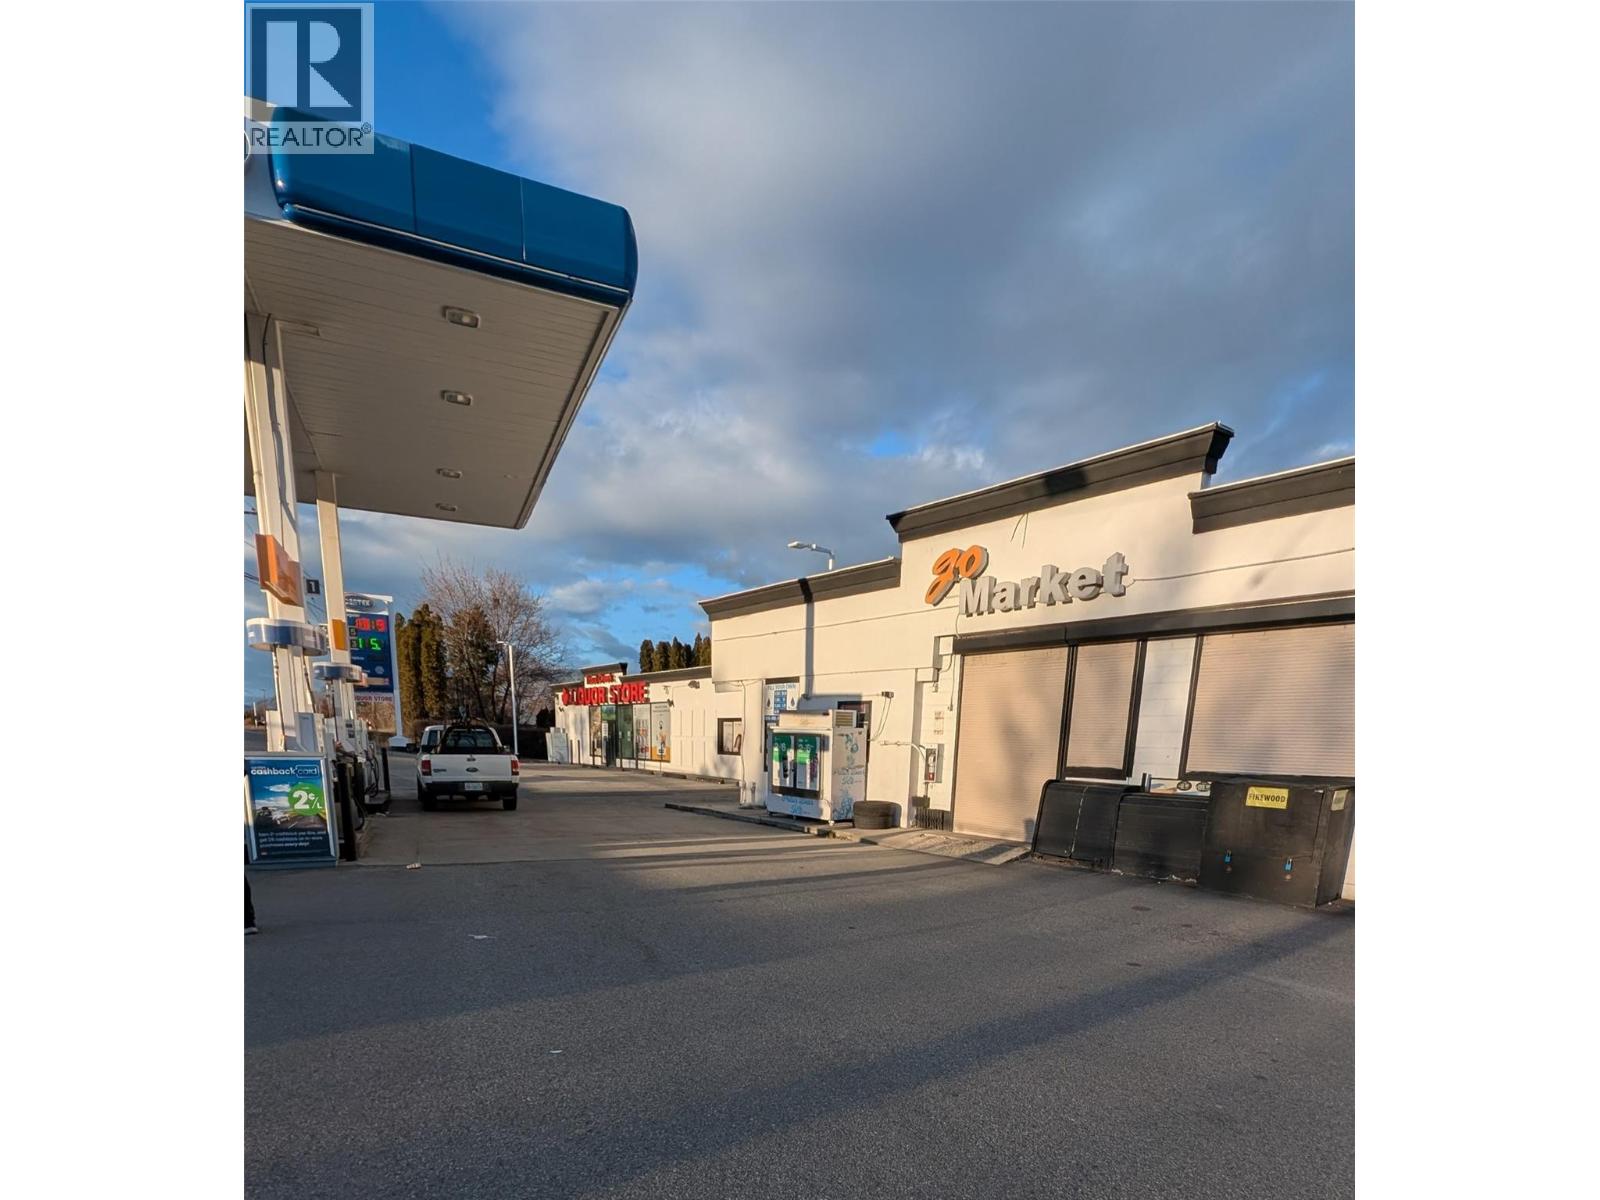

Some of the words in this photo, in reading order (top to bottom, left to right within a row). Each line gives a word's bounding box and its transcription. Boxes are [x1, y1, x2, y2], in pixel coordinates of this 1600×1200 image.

[925, 545, 987, 605] go
[958, 552, 1129, 617] Market
[568, 686, 606, 706] LIQUOR
[609, 680, 647, 704] STORE
[250, 767, 296, 776] cashback
[297, 767, 317, 775] card
